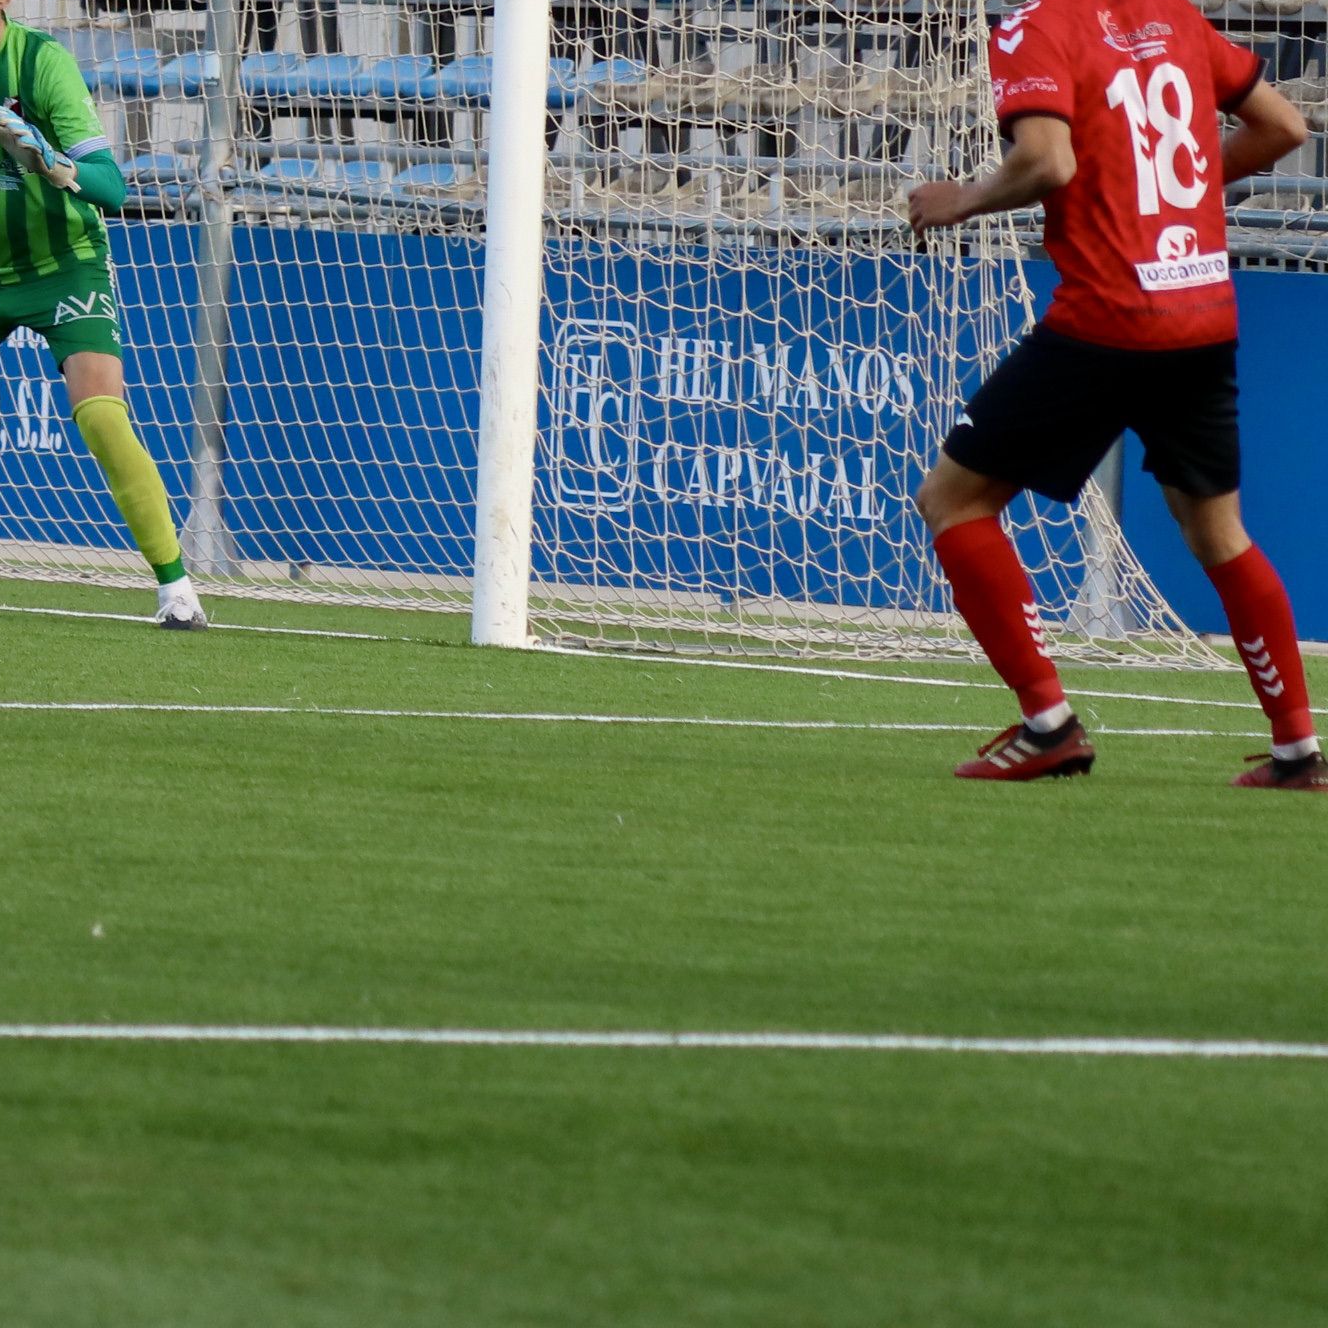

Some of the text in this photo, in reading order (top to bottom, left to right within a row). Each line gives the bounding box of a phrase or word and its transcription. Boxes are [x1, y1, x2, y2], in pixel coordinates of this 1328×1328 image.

[1106, 61, 1207, 217] 18
[53, 289, 117, 326] AVS
[16, 379, 63, 452] S.L.
